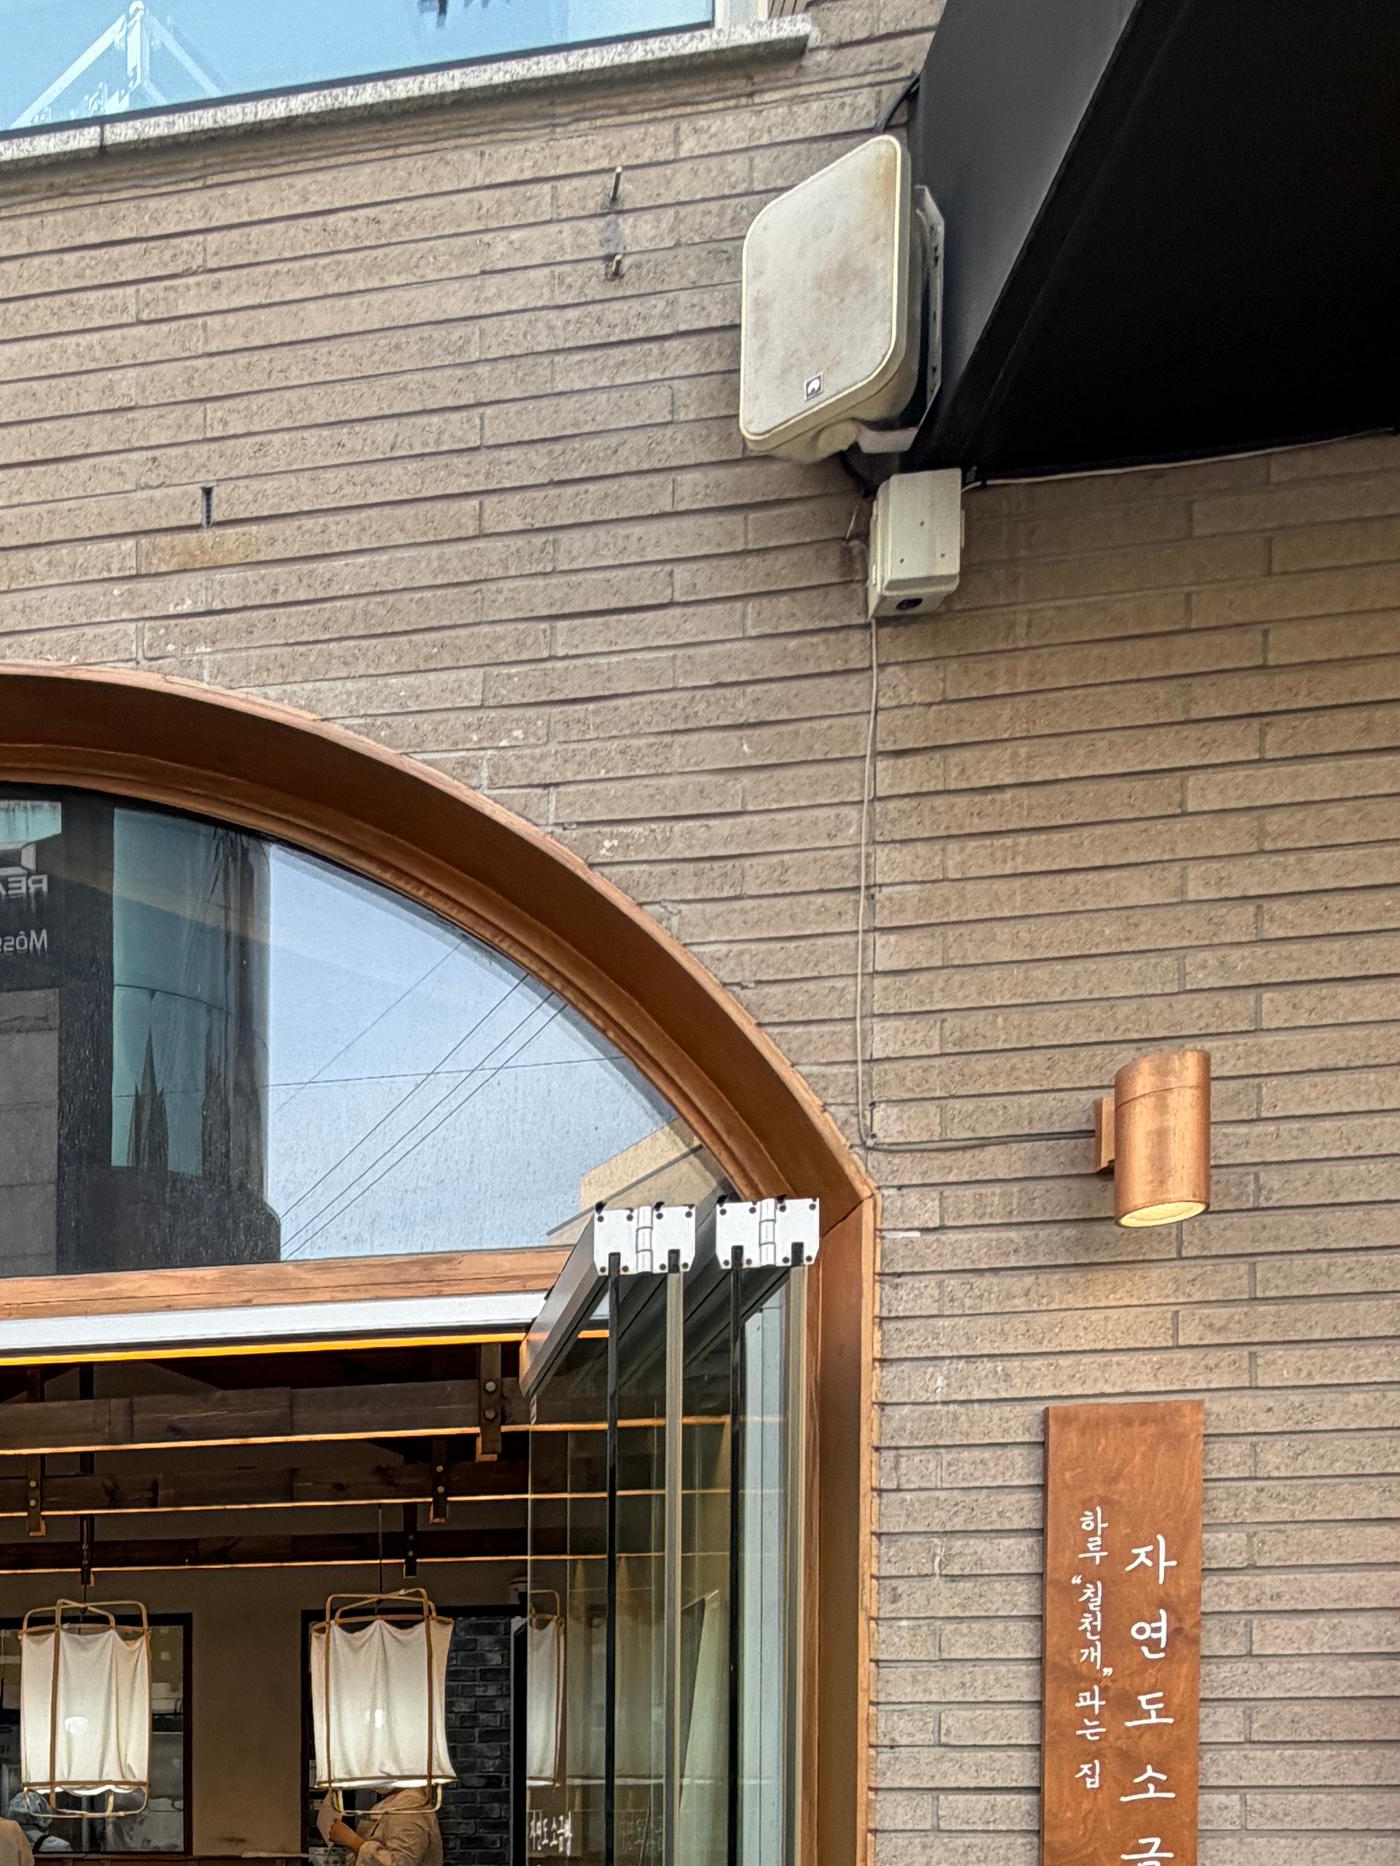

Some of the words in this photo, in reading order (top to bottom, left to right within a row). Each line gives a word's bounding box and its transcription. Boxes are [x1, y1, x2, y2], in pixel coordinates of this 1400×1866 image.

[1078, 1505, 1109, 1565] 하루
[1074, 1685, 1106, 1741] 파는
[1074, 1759, 1101, 1789] 집
